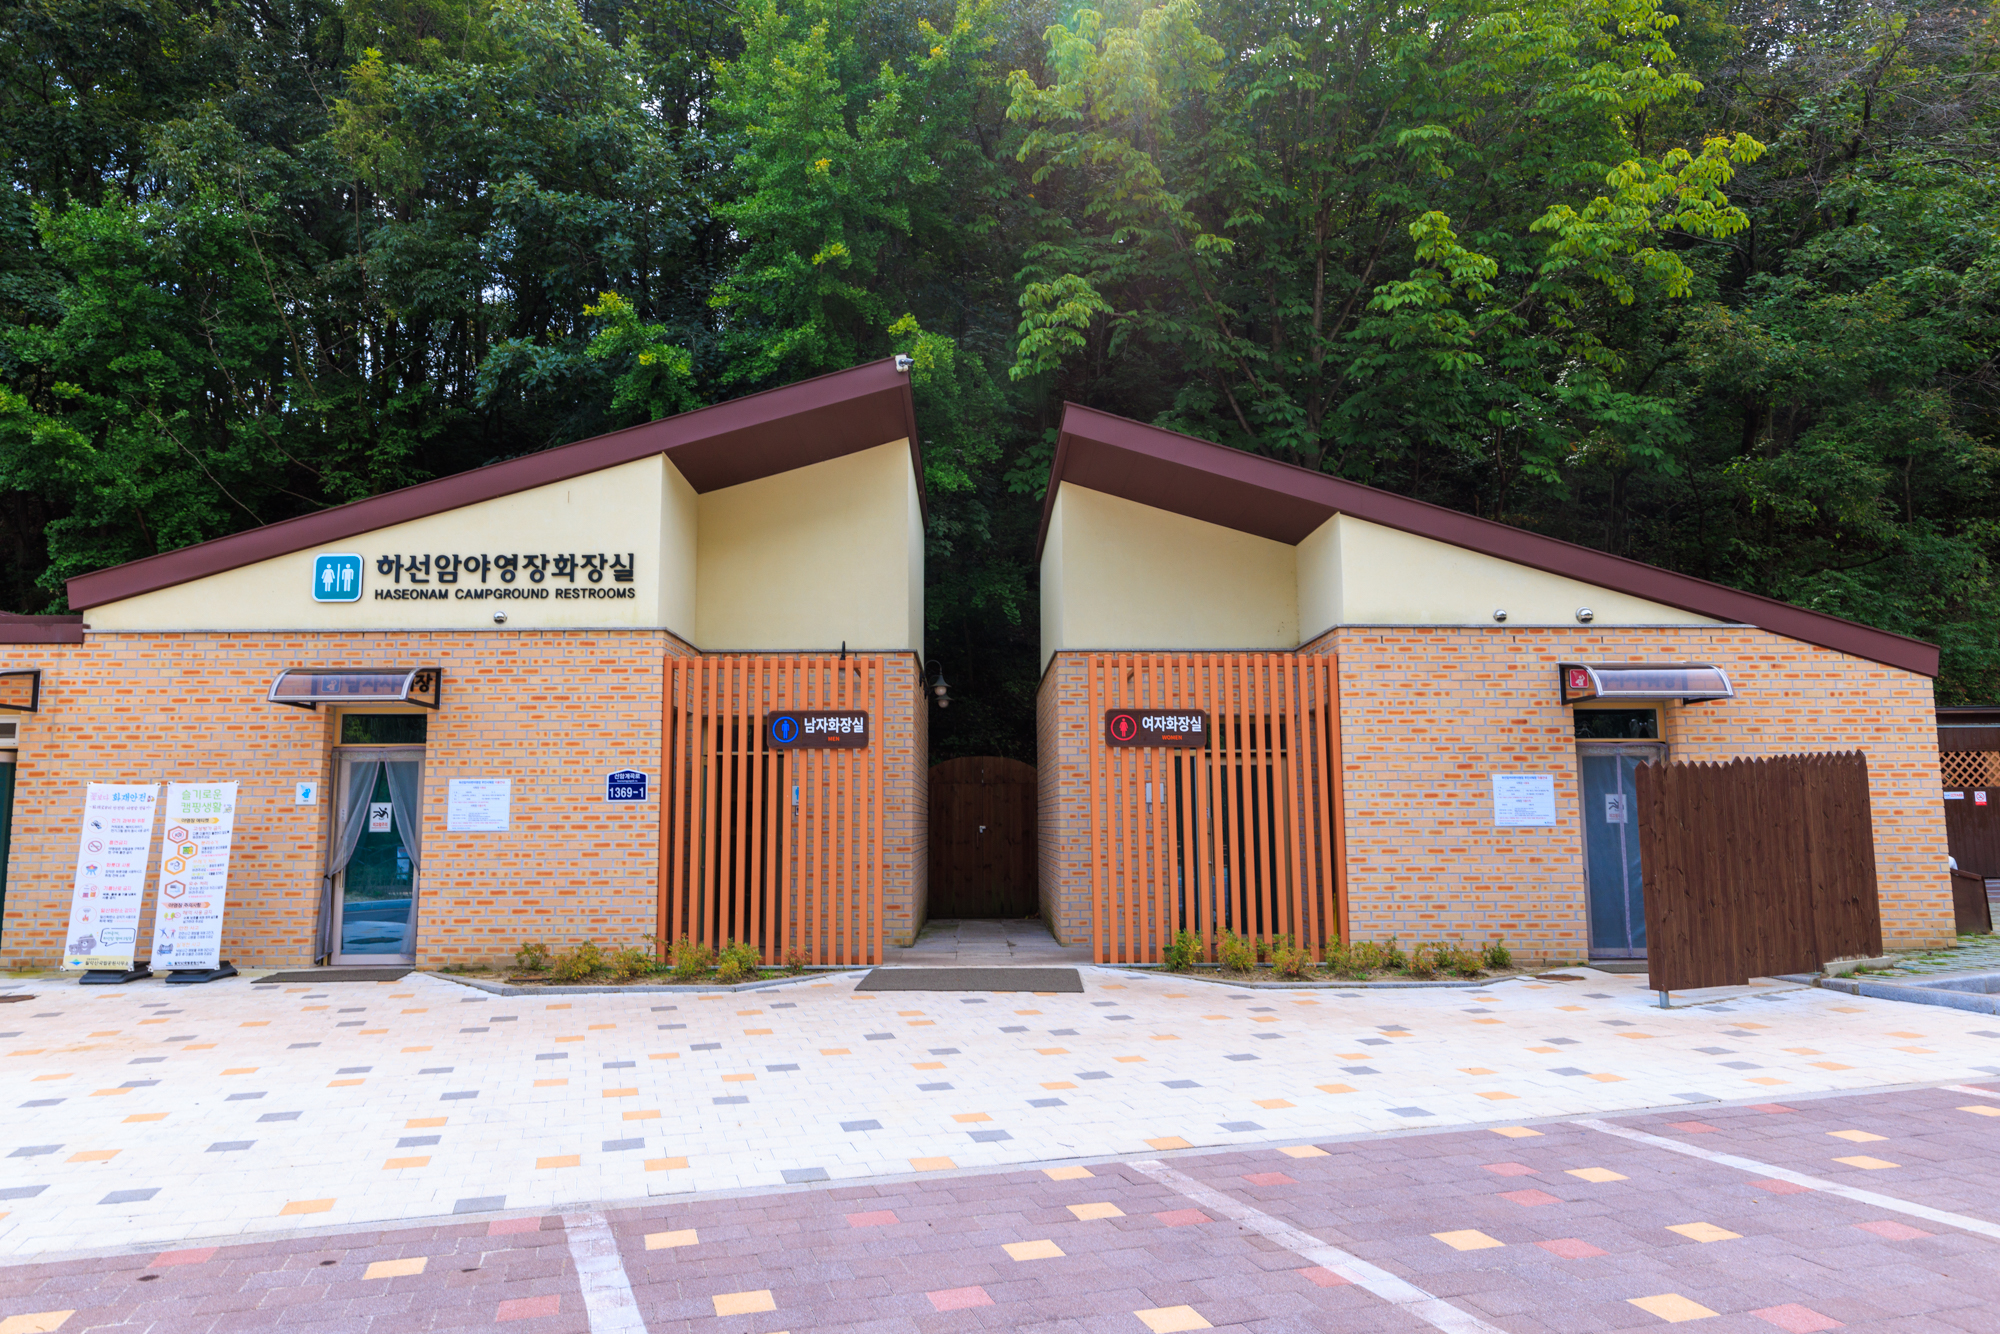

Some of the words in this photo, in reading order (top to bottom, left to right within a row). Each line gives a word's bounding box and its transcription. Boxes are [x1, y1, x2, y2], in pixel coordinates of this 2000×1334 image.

[376, 553, 634, 584] 하선암야영장화장실
[374, 588, 449, 600] HASEONAM
[454, 588, 549, 599] CAMPGROUND
[555, 588, 636, 599] RESTROOMS
[804, 717, 864, 734] 남자화장실
[1142, 715, 1202, 732] 여자화장실
[112, 792, 147, 802] 화재안전
[181, 789, 223, 801] 슬기로운
[609, 787, 644, 798] 1369-1
[180, 802, 223, 813] 캠핑생활
